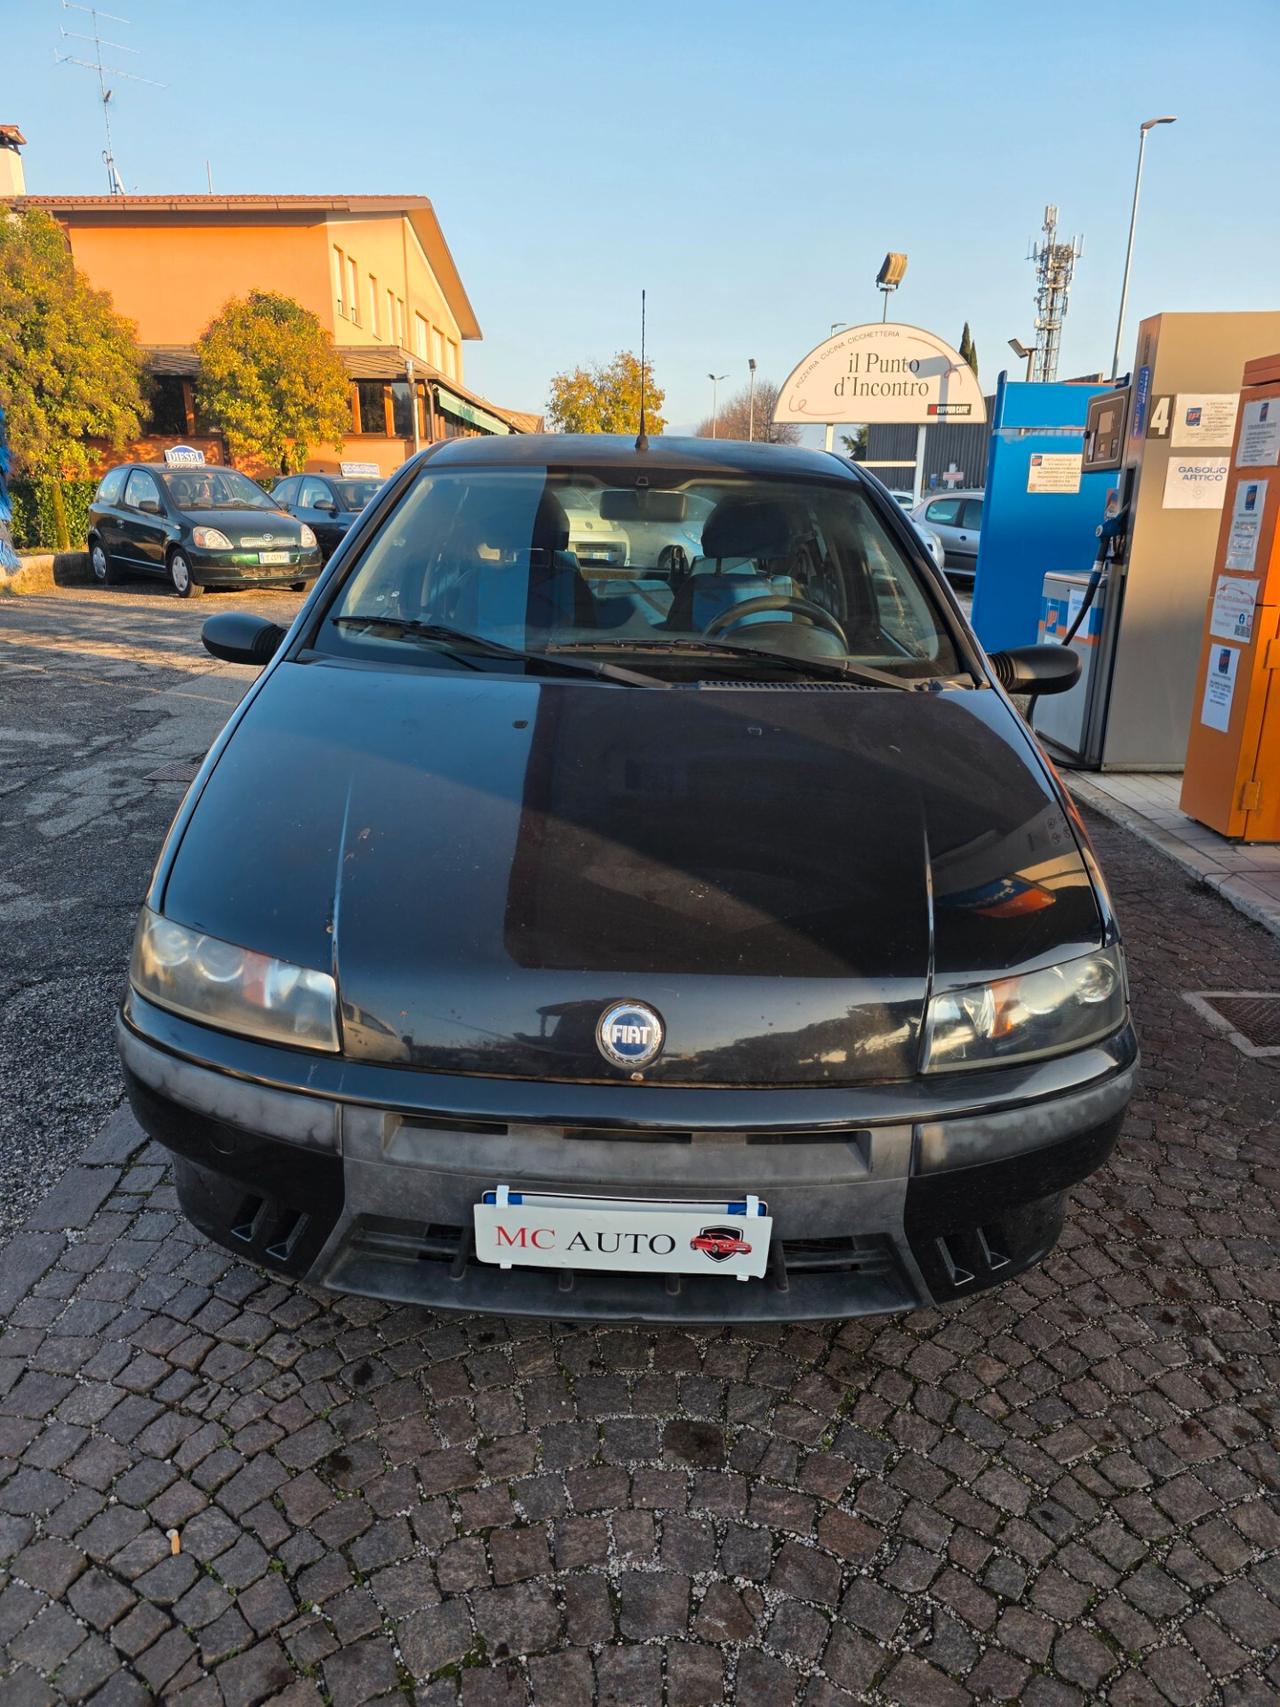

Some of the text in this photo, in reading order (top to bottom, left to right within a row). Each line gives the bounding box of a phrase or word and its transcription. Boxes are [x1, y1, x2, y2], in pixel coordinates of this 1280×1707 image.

[820, 342, 846, 360] CUCINA
[848, 352, 920, 374] il Punto
[834, 376, 929, 397] d'Incontro
[1150, 397, 1171, 436] 4
[167, 451, 204, 463] DIESEL
[1178, 466, 1228, 474] GASOLIO
[1182, 474, 1224, 482] ARTICO
[611, 1024, 651, 1045] FIAT
[495, 1225, 676, 1255] MC AUTO
